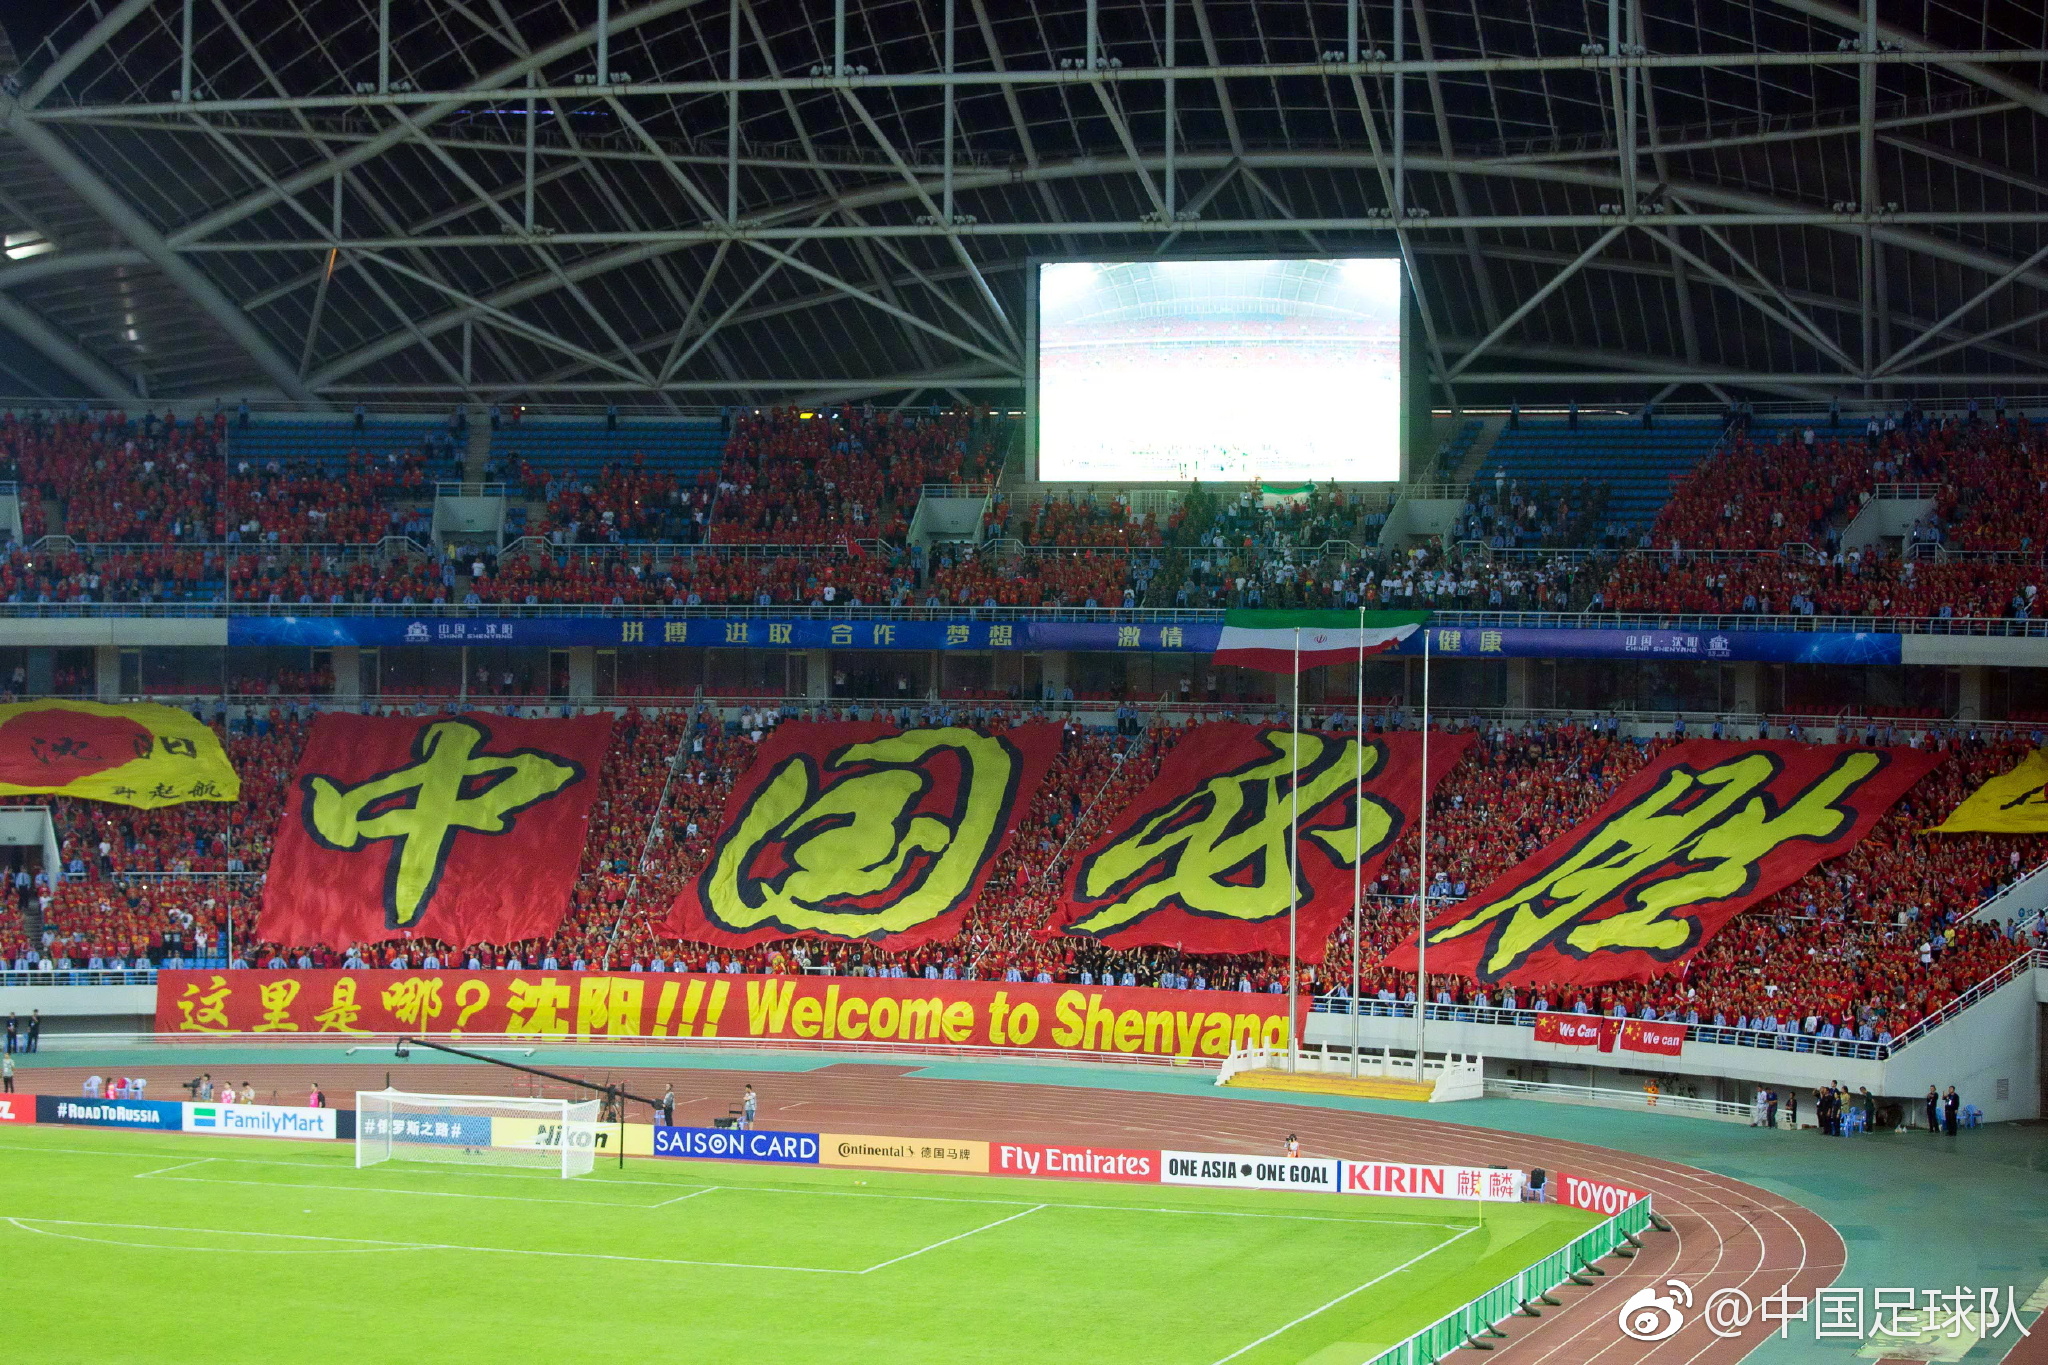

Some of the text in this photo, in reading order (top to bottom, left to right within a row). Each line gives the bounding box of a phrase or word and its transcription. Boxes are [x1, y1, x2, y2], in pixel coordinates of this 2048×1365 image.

[621, 621, 1503, 652] 拼搏 进取 合作 梦想 激情 健康
[303, 716, 585, 930] 中
[746, 979, 1290, 1065] Welcome to Shenyang
[1559, 1021, 1597, 1038] We Can
[1643, 1031, 1680, 1046] We can
[224, 1109, 325, 1133] FamilyMart
[535, 1124, 610, 1149] Nikon
[656, 1130, 817, 1159] SAISON CARD
[838, 1141, 905, 1158] Continental
[921, 1146, 971, 1161] 德国马牌
[1000, 1145, 1150, 1176] Fly Emirates
[1169, 1158, 1329, 1184] ONE ASIA ONE GOAL
[1348, 1164, 1445, 1195] KIRIN
[1566, 1177, 1637, 1214] TOYOTA
